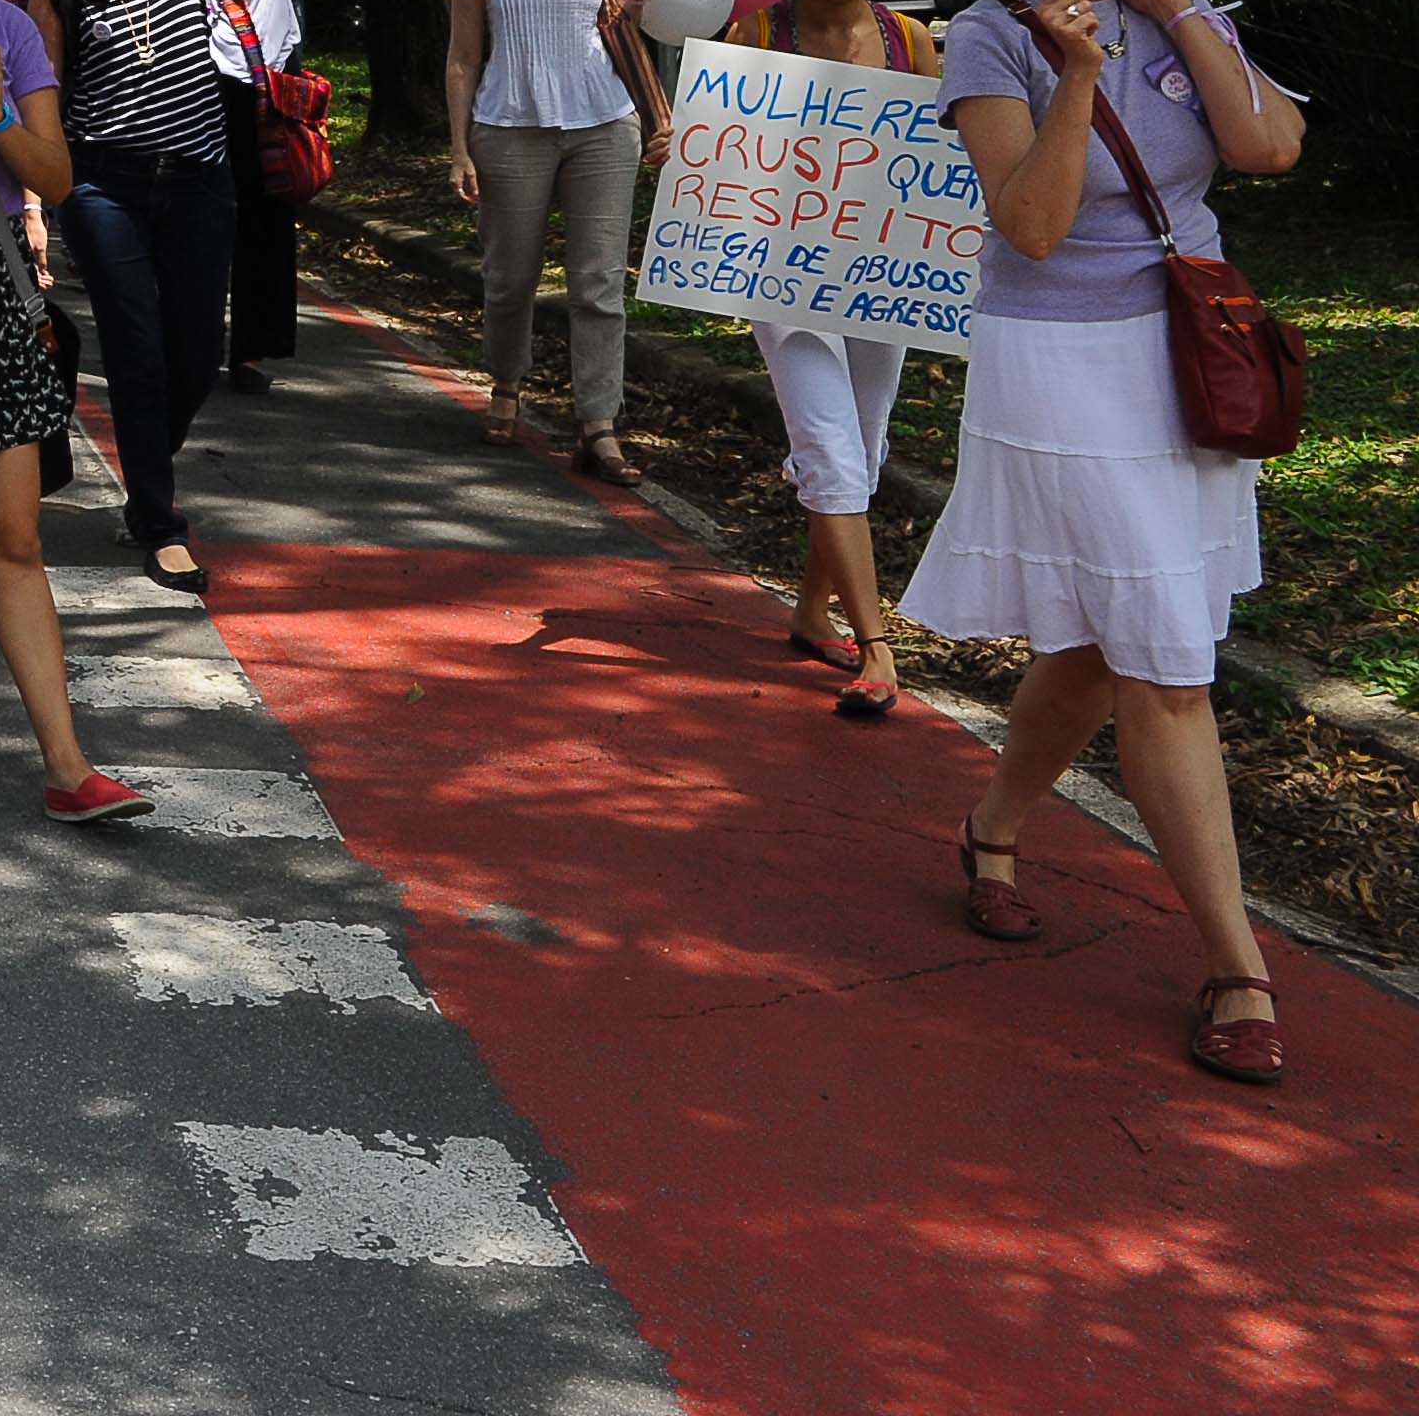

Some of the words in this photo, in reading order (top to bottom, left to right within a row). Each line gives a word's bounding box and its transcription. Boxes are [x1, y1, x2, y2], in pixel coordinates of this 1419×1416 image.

[679, 123, 881, 191] CRUSP
[672, 173, 985, 259] RESPEITO
[648, 255, 803, 306] ASSÉDIOS
[809, 284, 843, 314] E
[655, 220, 771, 269] CHEGA
[785, 244, 831, 276] DE
[844, 254, 972, 296] ABUSOS
